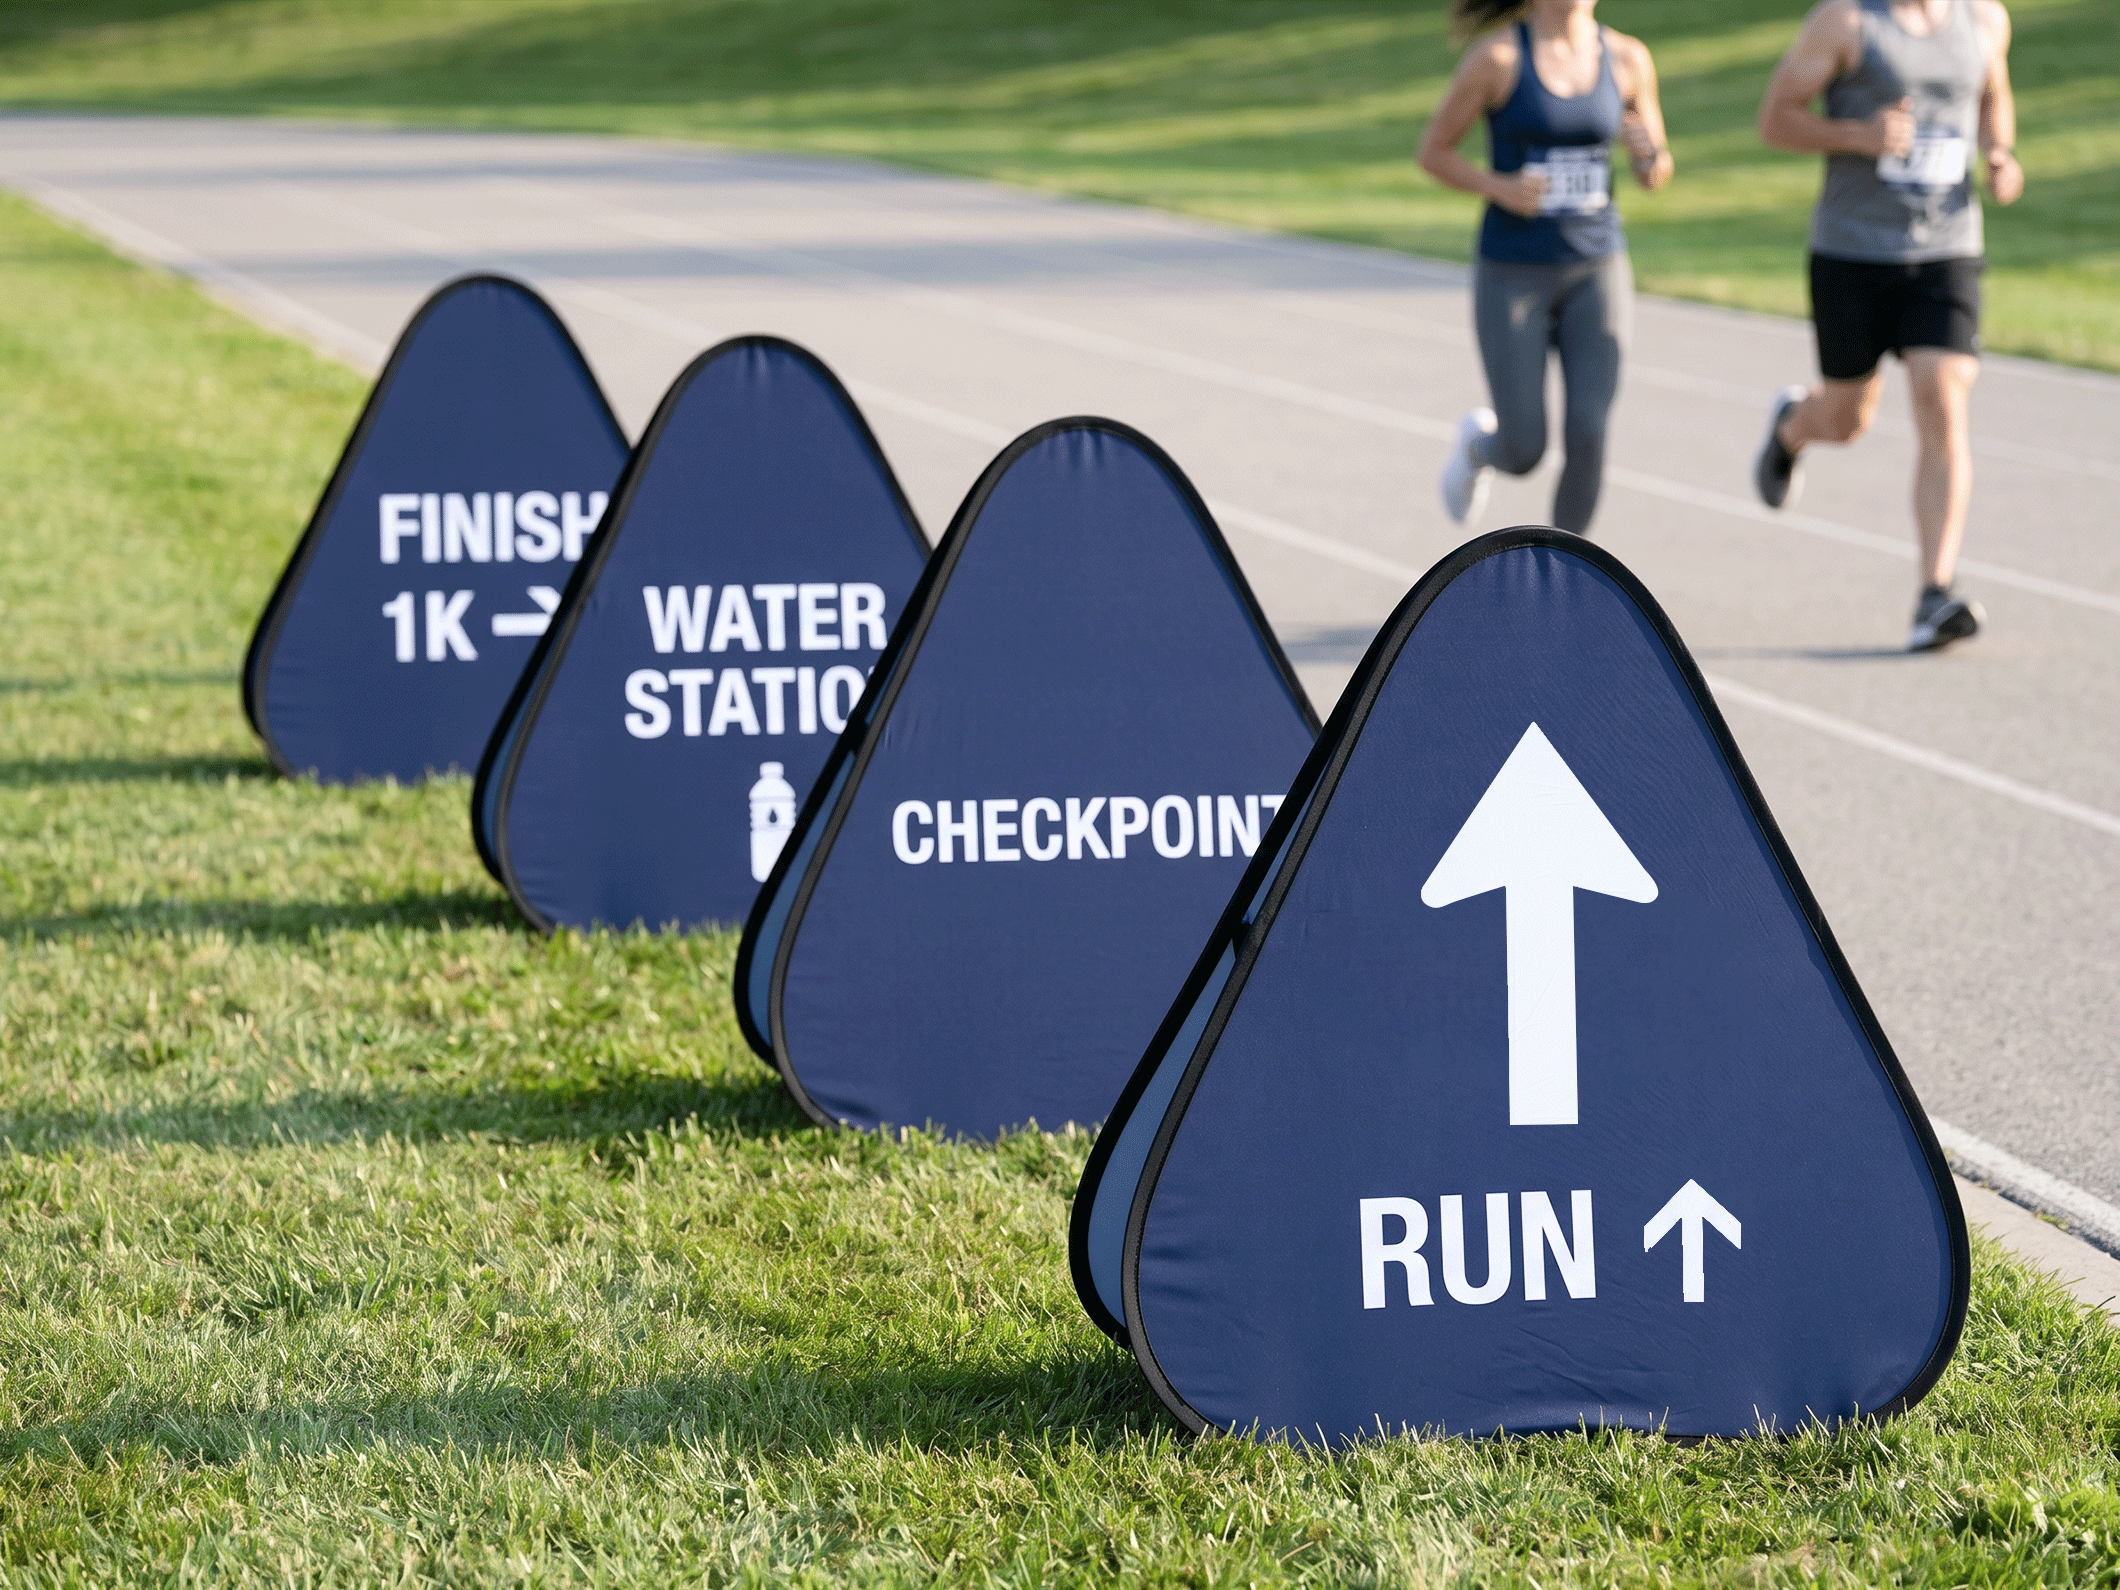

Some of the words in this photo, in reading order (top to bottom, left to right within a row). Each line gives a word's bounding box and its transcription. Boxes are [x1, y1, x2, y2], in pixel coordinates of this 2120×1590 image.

[379, 490, 609, 564] FINISH
[382, 589, 479, 663] 1K
[642, 582, 888, 654] WATER
[624, 664, 875, 740] STATIO
[892, 794, 1288, 865] CHECKPOIN
[1359, 1189, 1597, 1310] RUN
